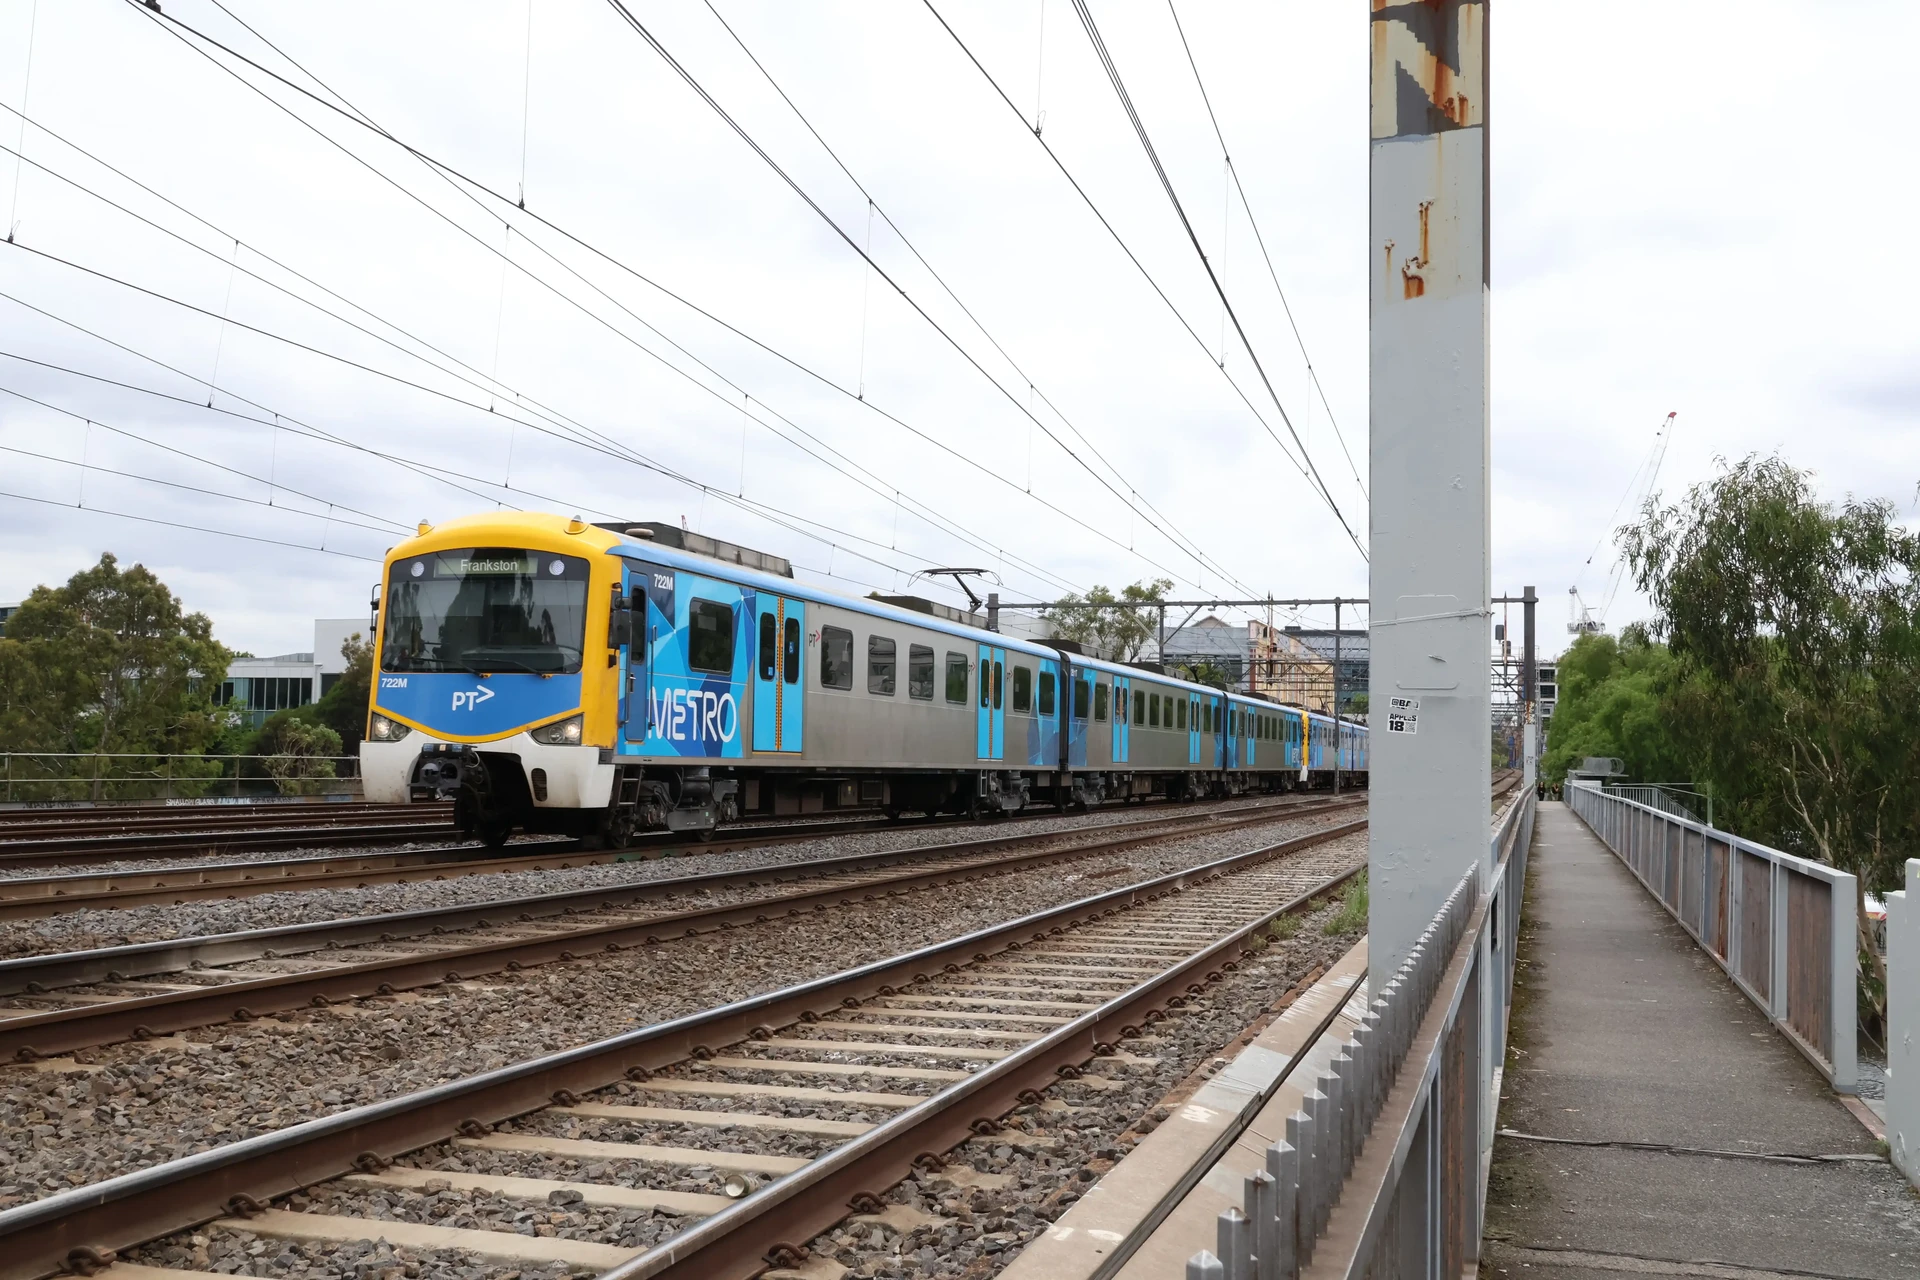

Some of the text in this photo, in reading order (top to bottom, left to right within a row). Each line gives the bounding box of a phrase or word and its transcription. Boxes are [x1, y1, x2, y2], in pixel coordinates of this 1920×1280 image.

[460, 559, 518, 571] Frankston
[653, 573, 674, 591] 722M
[381, 678, 408, 688] 722M
[647, 686, 737, 743] METRO
[1389, 720, 1405, 731] 18
